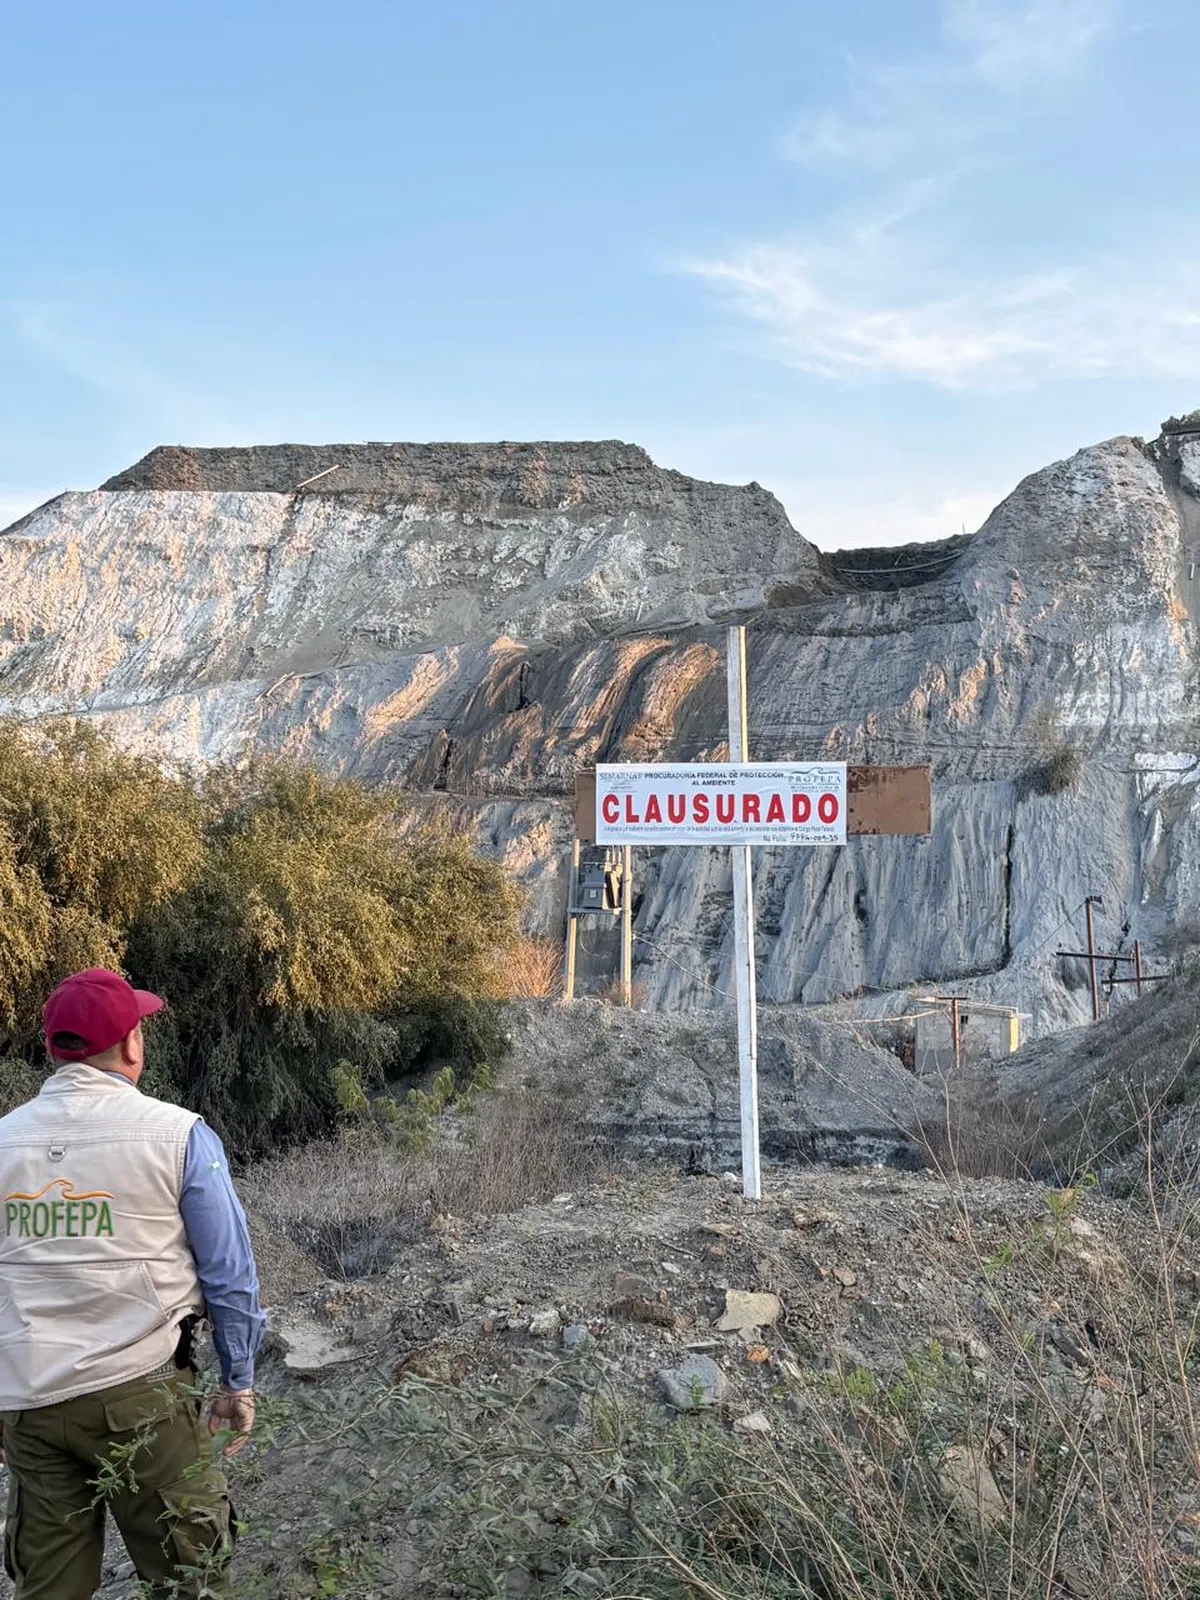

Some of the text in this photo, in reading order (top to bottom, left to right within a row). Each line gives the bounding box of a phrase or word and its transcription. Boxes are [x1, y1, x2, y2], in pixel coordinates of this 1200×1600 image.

[697, 771, 727, 779] FEDERAL
[729, 770, 738, 779] DE
[602, 793, 839, 824] CLAUSURADO
[5, 1201, 113, 1237] PROFEPA
